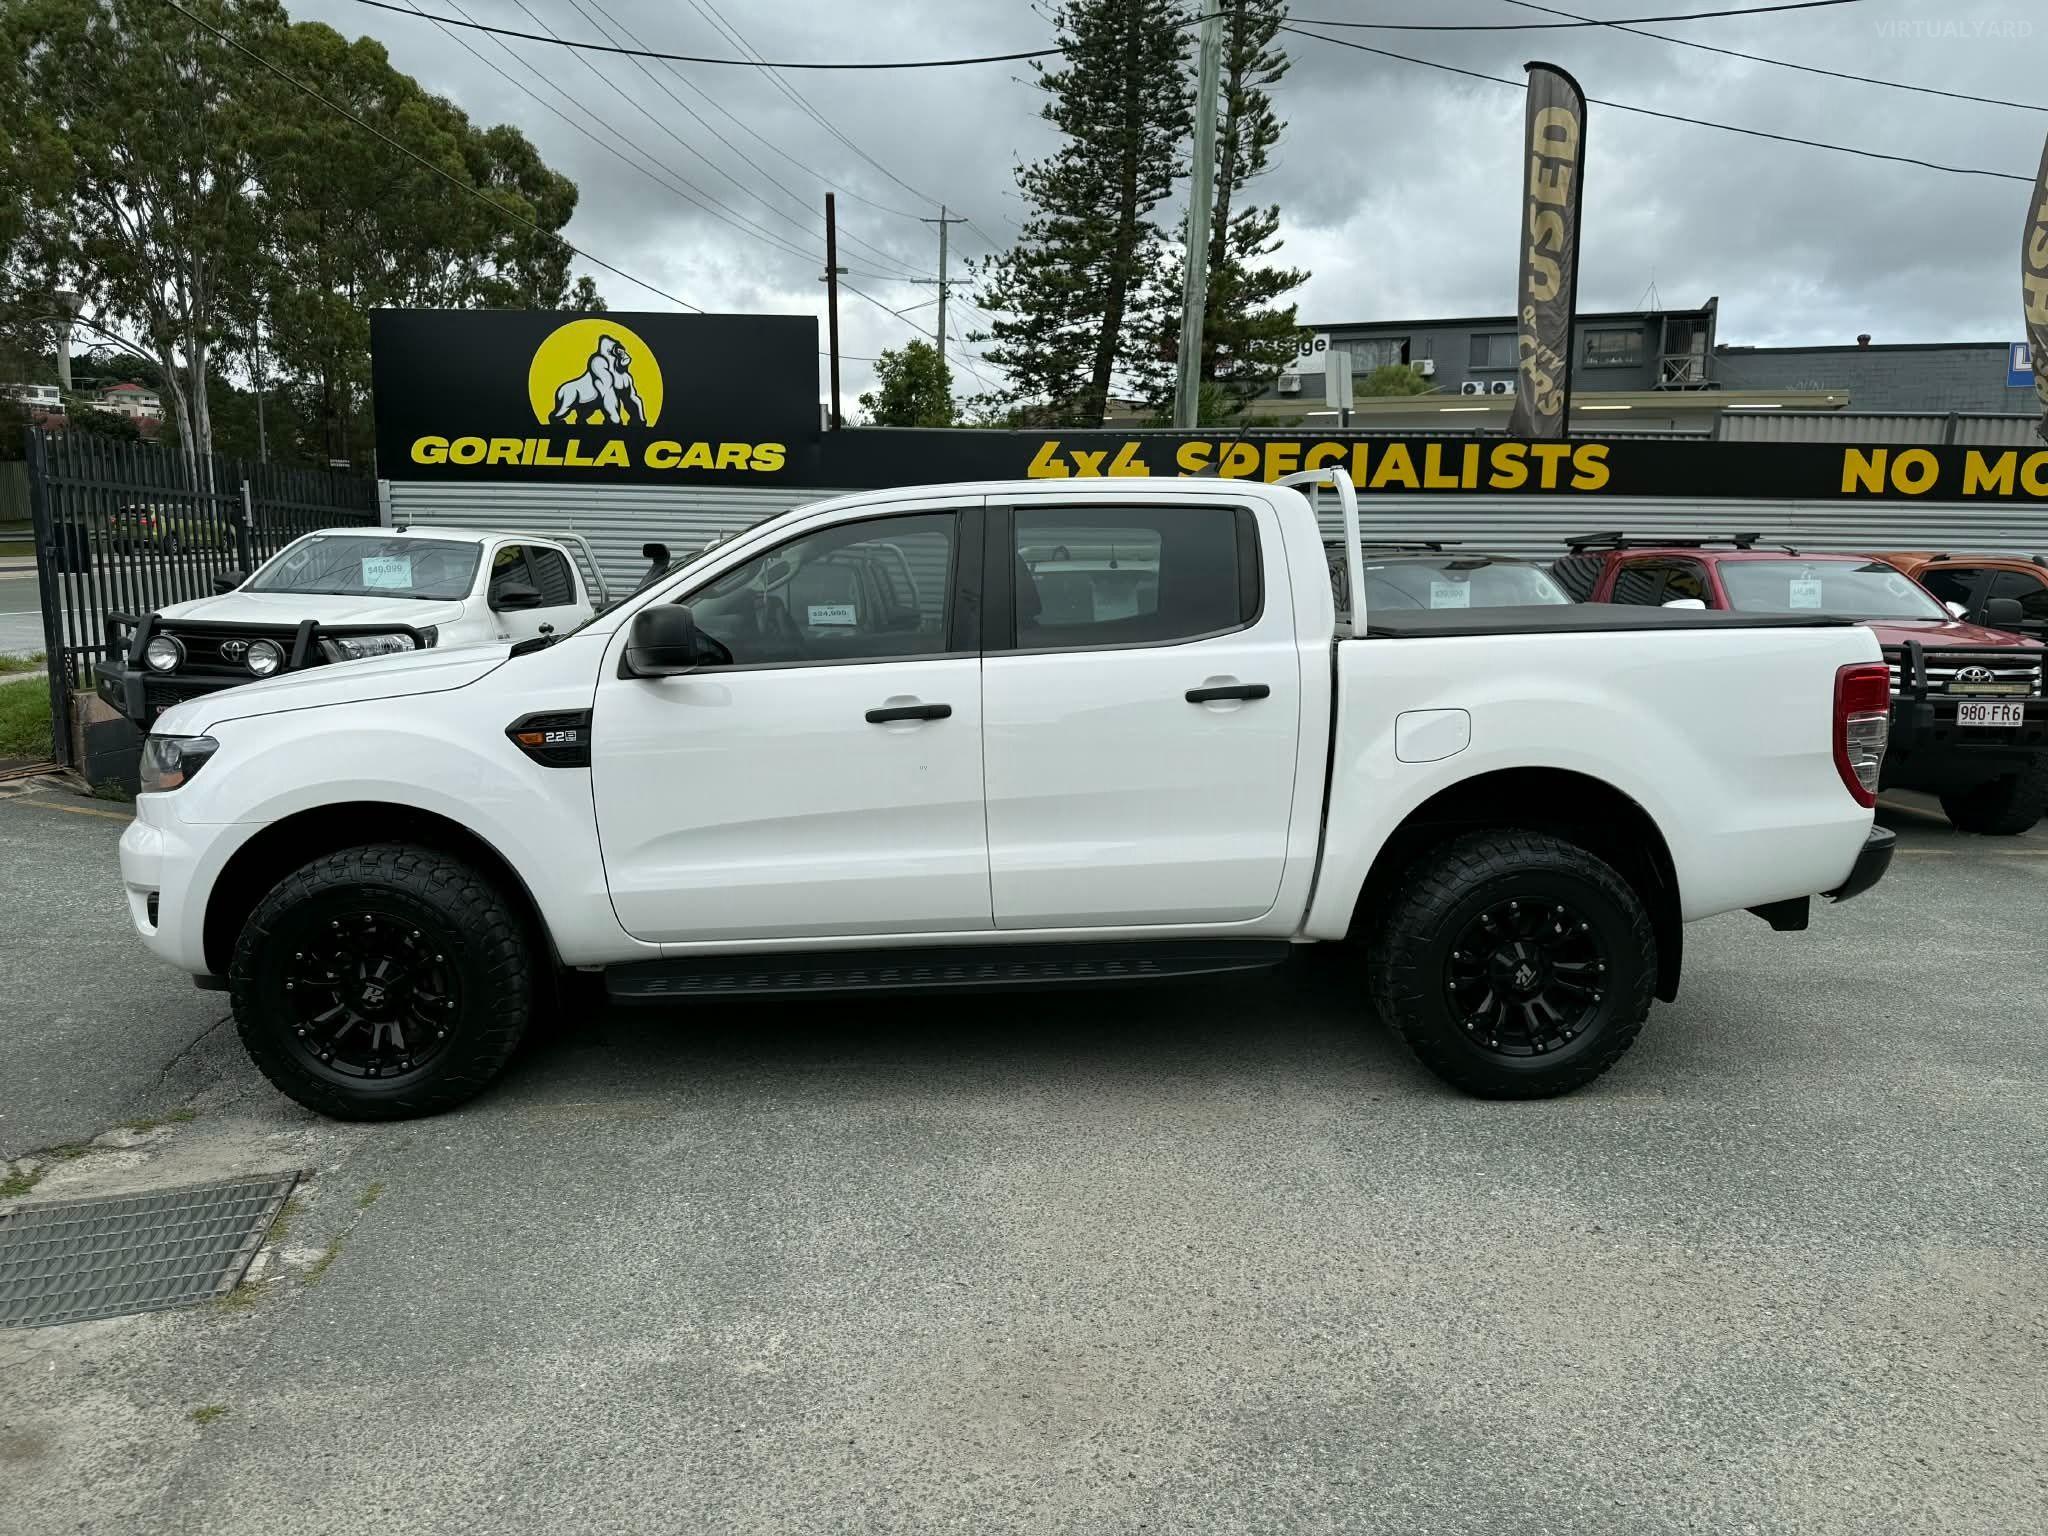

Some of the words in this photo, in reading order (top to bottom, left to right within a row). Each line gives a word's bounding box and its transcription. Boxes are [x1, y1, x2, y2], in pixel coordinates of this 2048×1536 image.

[1527, 106, 1579, 302] USED
[410, 435, 631, 468] GORILLA
[643, 440, 787, 472] CARS
[1027, 440, 1151, 478] 4x4
[1176, 441, 1611, 490] SPECIALISTS
[1841, 448, 1940, 495] NO
